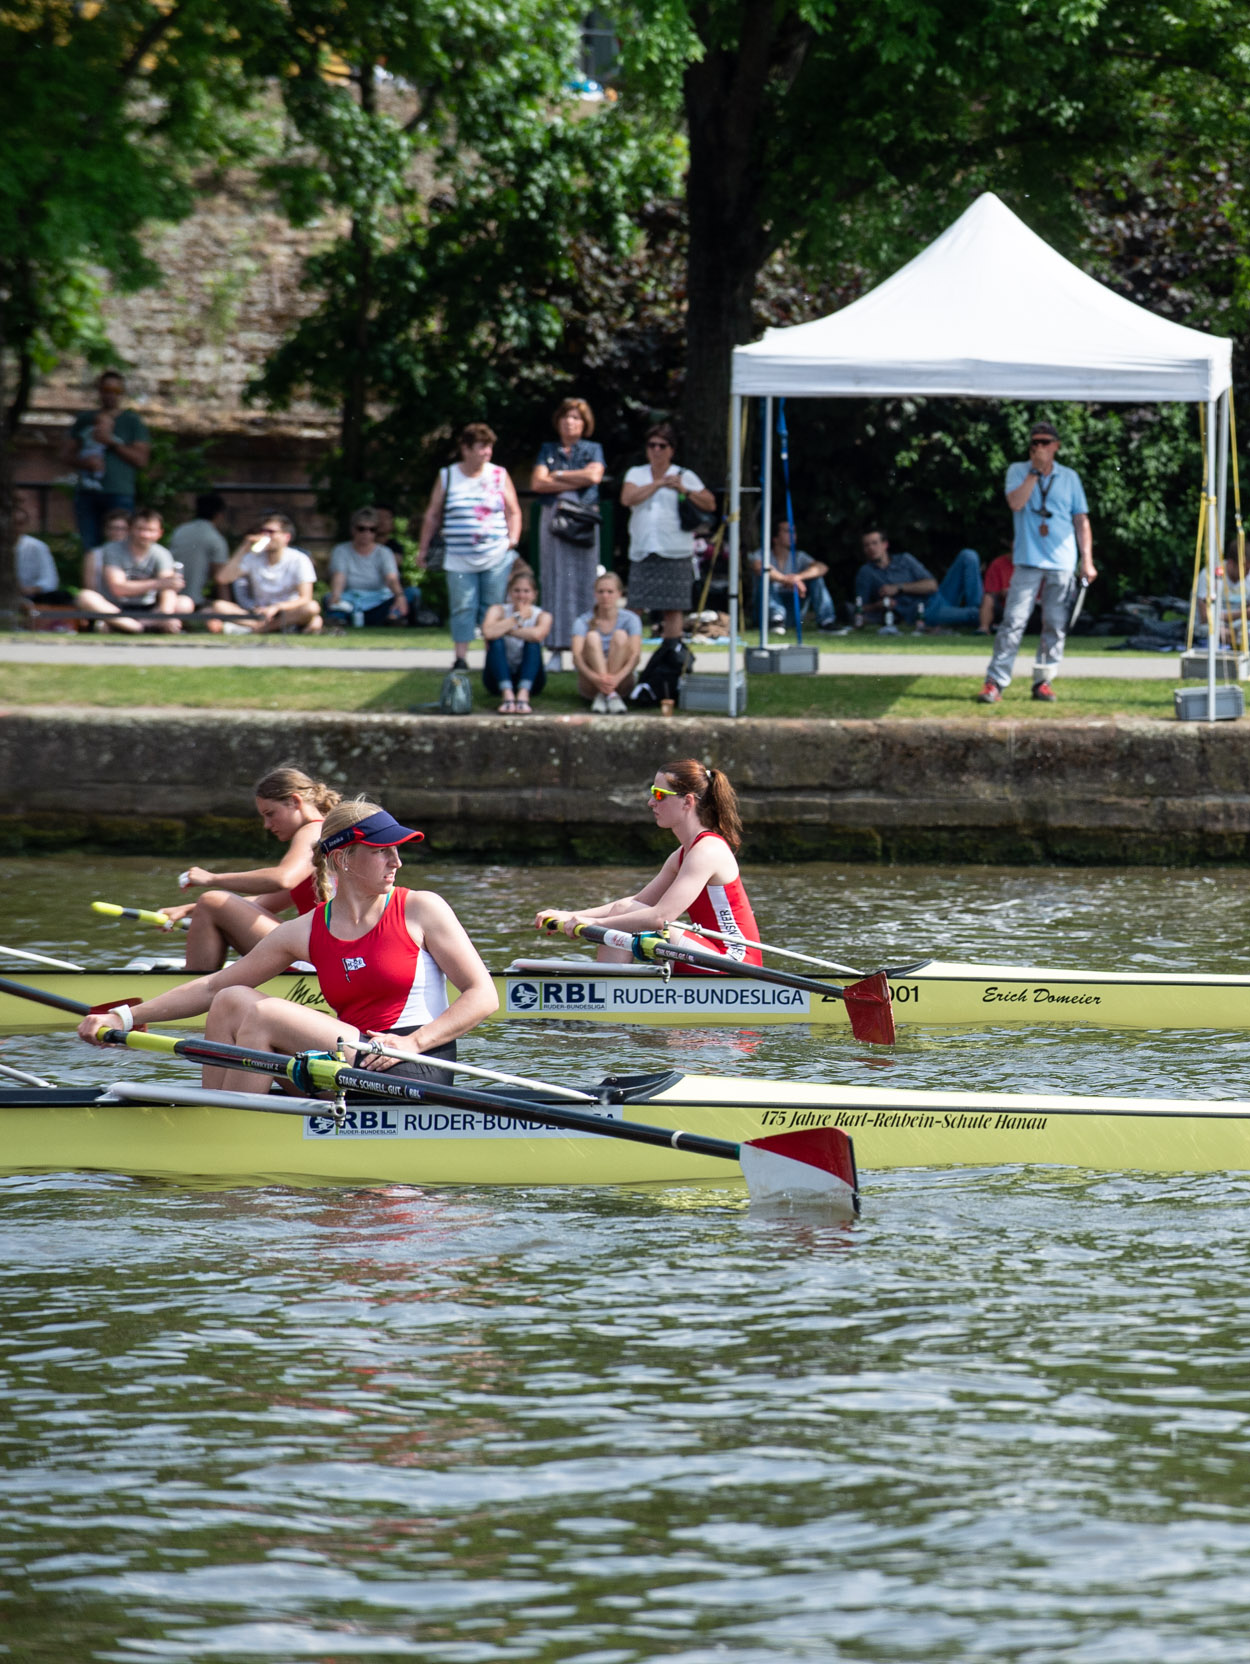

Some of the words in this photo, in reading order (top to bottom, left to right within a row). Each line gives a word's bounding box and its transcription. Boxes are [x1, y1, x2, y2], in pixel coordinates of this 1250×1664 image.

[544, 983, 605, 1003] RBL
[613, 988, 804, 1005] RUDER-BUNDESLIGA
[982, 986, 1028, 1003] Erich
[1033, 987, 1102, 1005] Domeier
[338, 1075, 359, 1088] STARK.
[359, 1079, 388, 1093] SCHNELL.
[388, 1084, 403, 1096] GUT.
[340, 1111, 397, 1129] RBL
[761, 1110, 788, 1126] 175
[787, 1111, 832, 1128] Jahre
[834, 1111, 993, 1129] Karl-Rehbein-Schule
[994, 1114, 1048, 1130] Hanau
